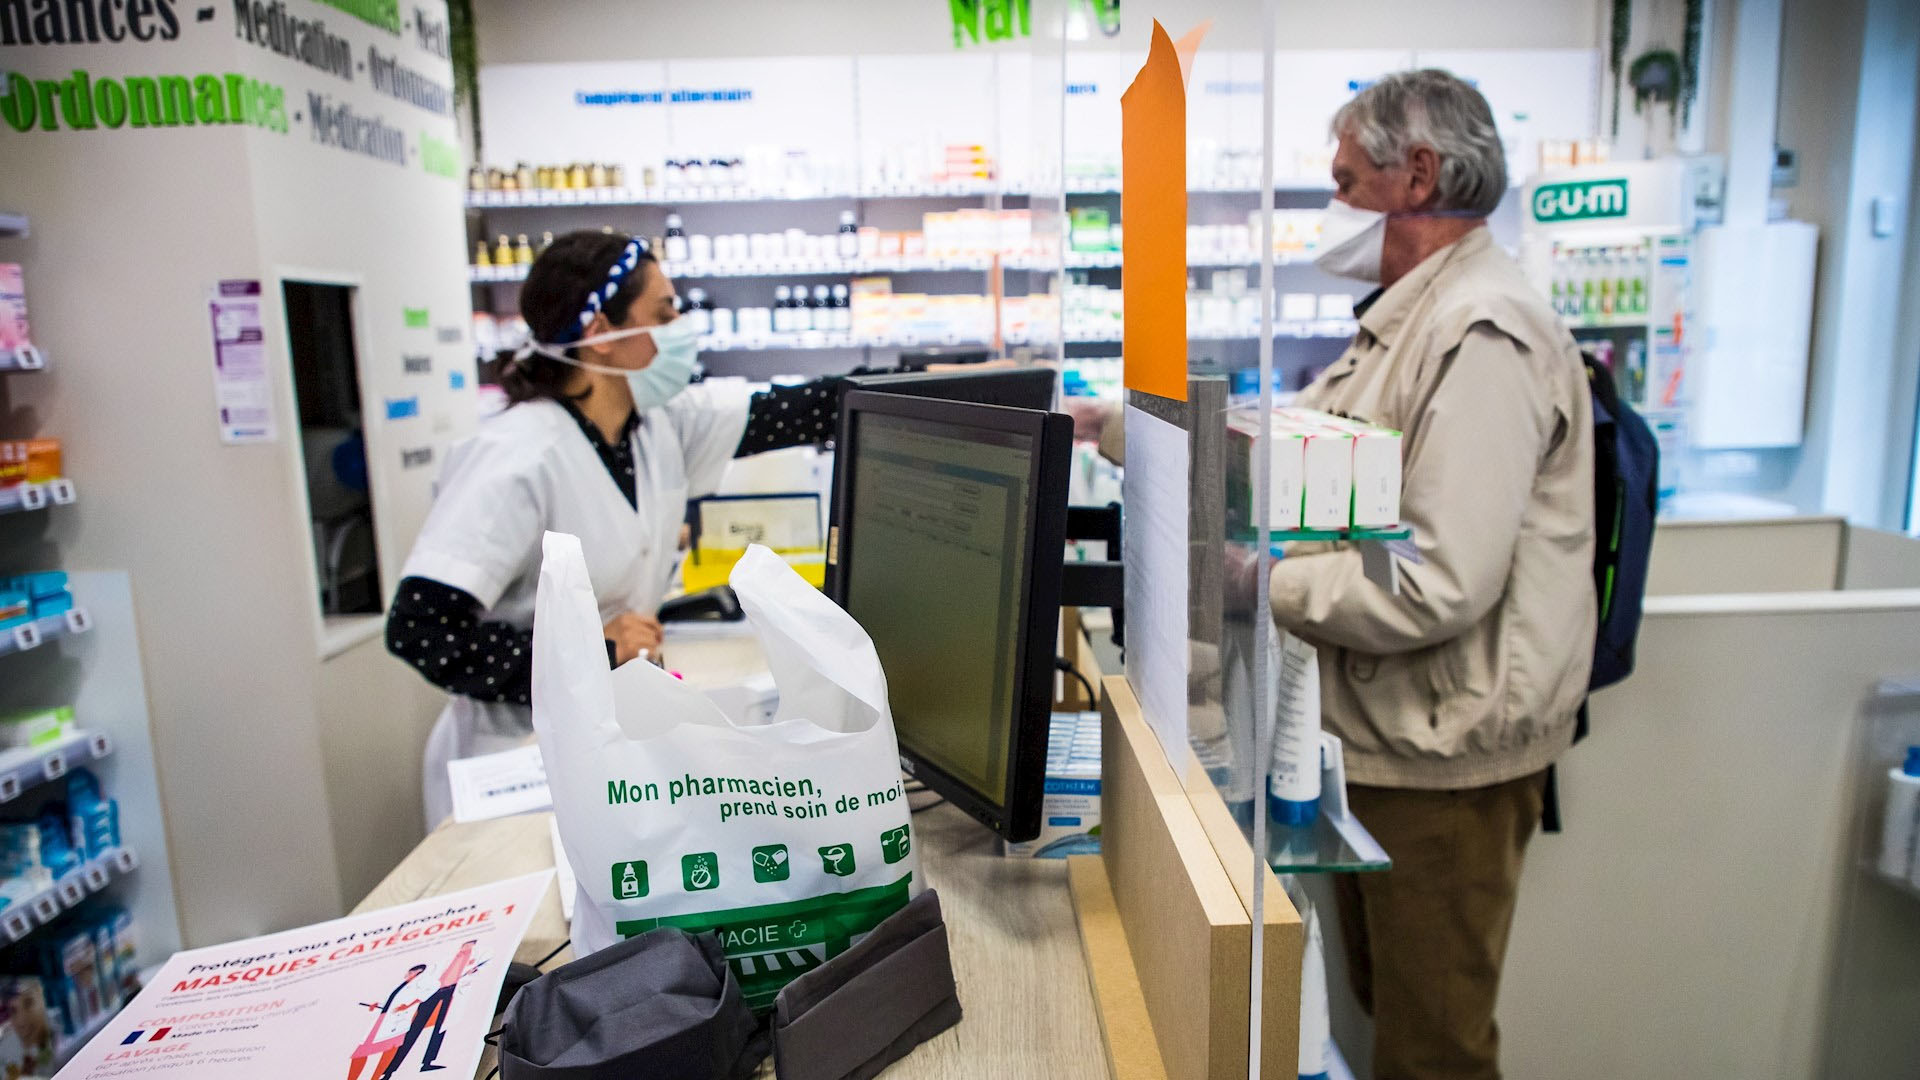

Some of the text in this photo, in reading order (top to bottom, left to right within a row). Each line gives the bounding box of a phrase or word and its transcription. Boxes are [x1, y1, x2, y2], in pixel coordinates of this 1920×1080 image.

[0, 69, 288, 133] Ordonnances
[607, 774, 822, 805] Mon pharmacien,
[720, 800, 778, 822] prend
[783, 801, 827, 819] soin
[835, 795, 859, 814] de
[337, 933, 355, 943] et
[363, 926, 392, 937] vos
[399, 904, 478, 932] proches
[172, 954, 322, 993] MASQUES
[328, 909, 493, 961] CATÉGORIE
[504, 904, 516, 915] 1
[138, 999, 287, 1027] COMPOSITION
[171, 1030, 202, 1039] Made
[220, 1023, 259, 1033] France
[104, 1042, 192, 1060] LAVAGE
